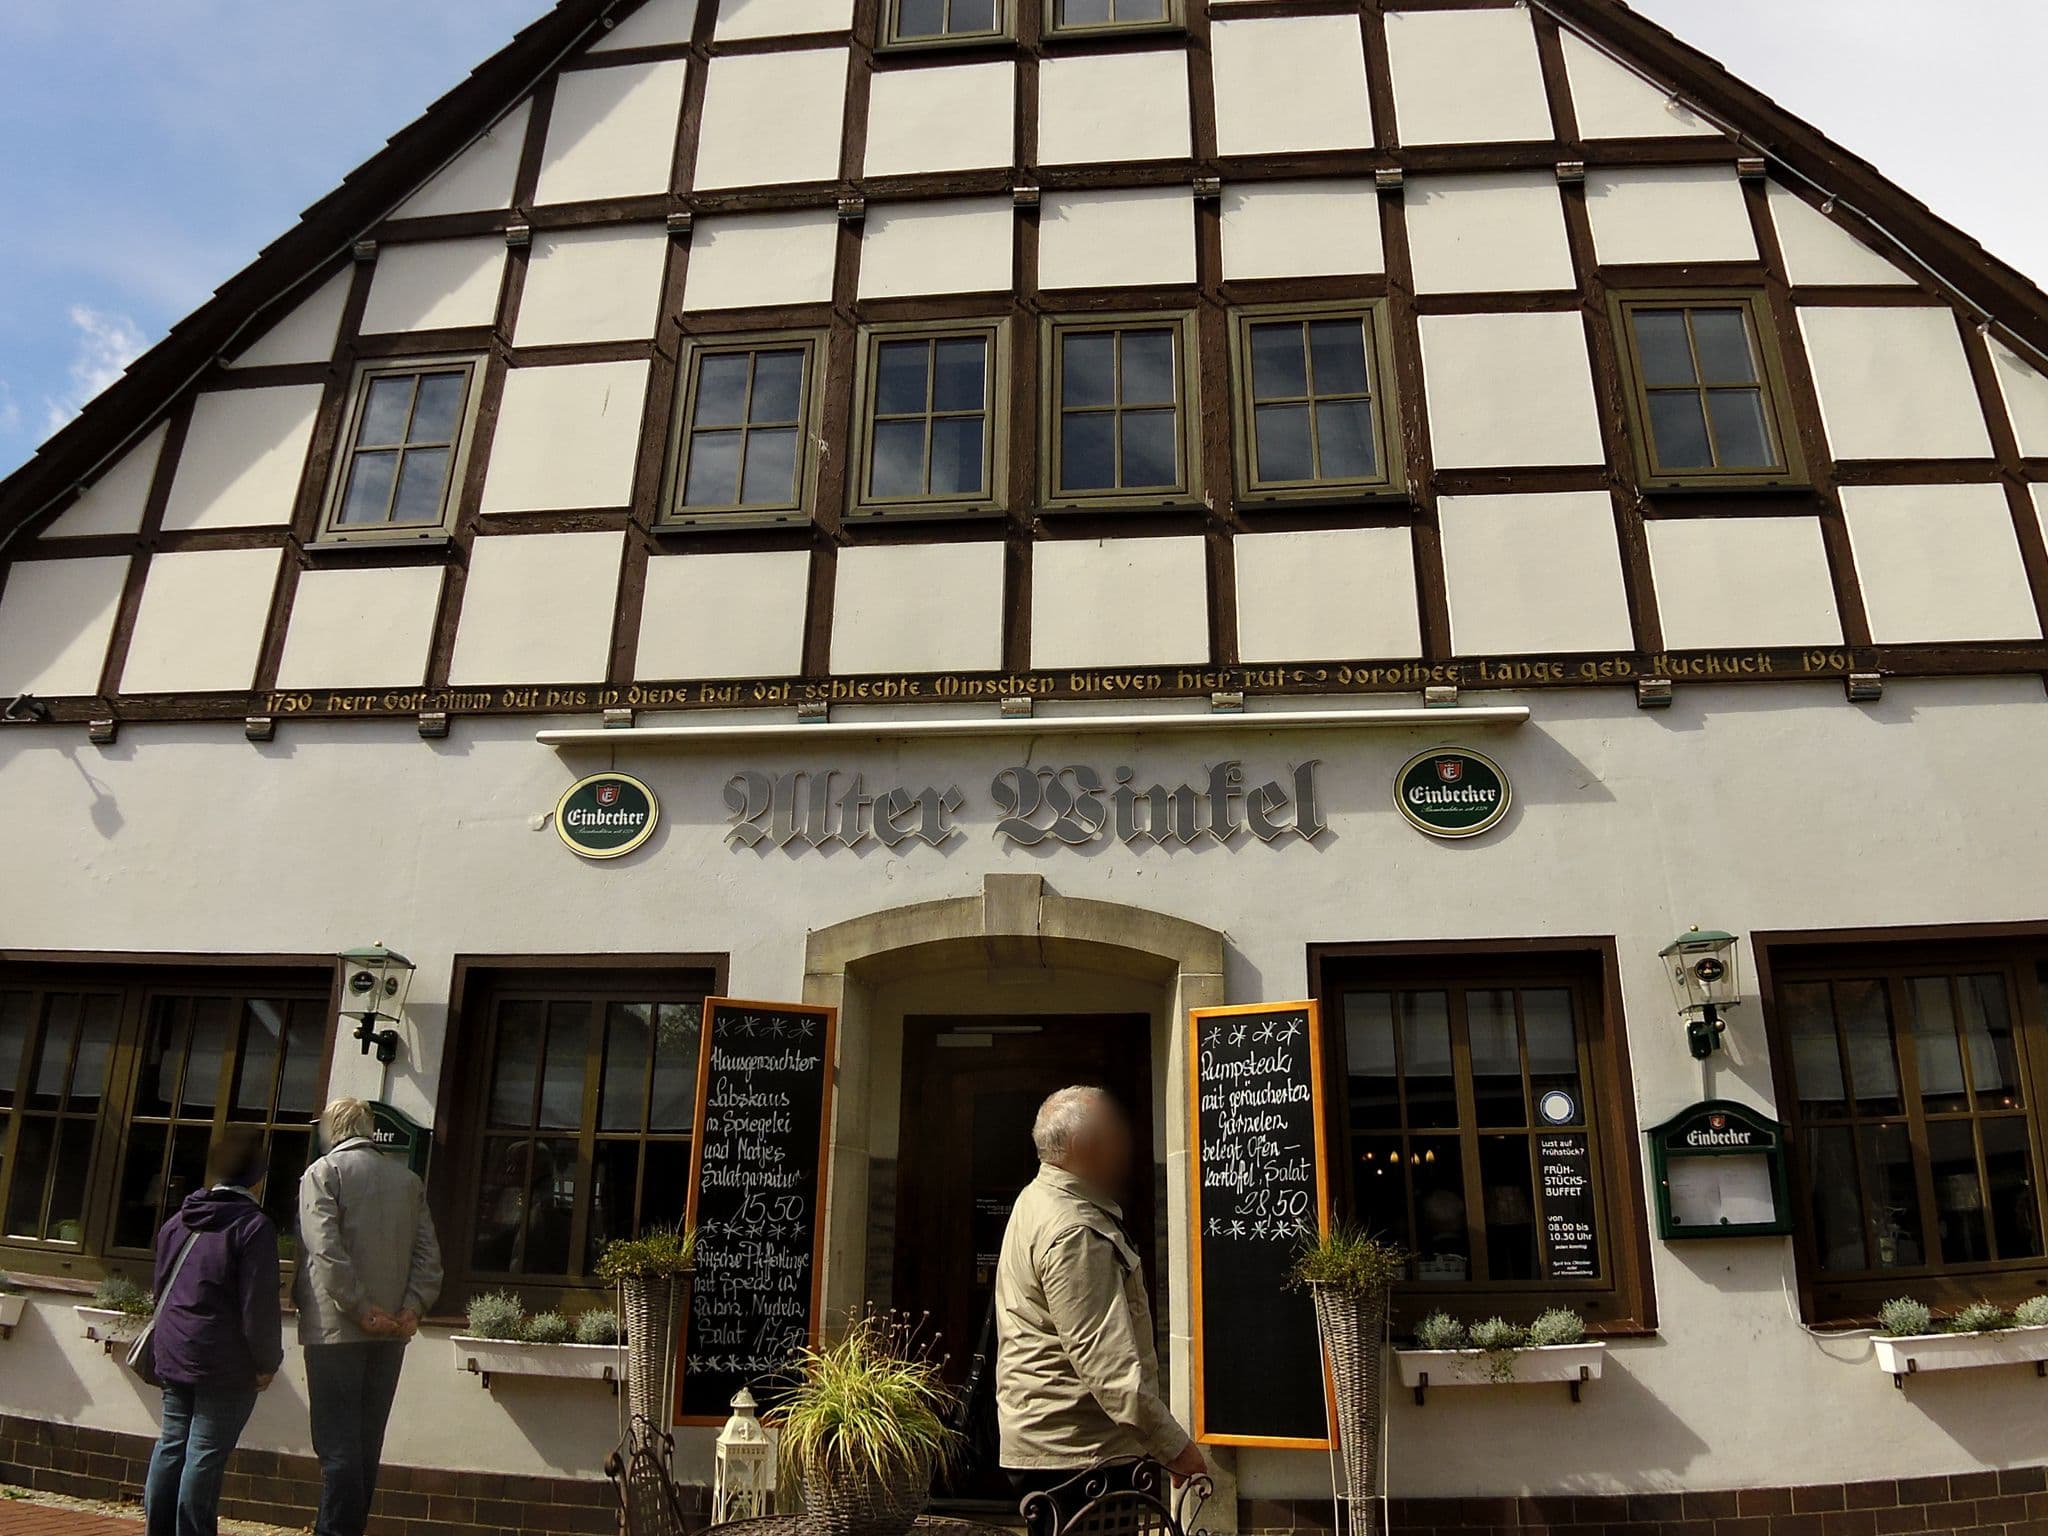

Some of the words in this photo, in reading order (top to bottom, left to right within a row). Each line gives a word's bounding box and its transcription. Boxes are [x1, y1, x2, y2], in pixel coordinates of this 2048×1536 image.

[384, 690, 428, 711] Gott
[598, 688, 619, 705] in
[628, 685, 688, 704] diene
[753, 681, 791, 701] dat
[805, 677, 921, 700] schlechte
[935, 675, 1055, 696] Minschen
[1070, 672, 1162, 692] blieven
[1177, 669, 1231, 689] hier
[1480, 660, 1565, 682] Lange
[1580, 657, 1639, 681] geb.
[723, 768, 967, 848] Alter
[991, 759, 1329, 847] Winkel
[1409, 784, 1496, 805] Einbecker
[567, 808, 645, 826] Einbecker
[1201, 1046, 1293, 1088] Rumpsteak
[708, 1076, 790, 1108] Labskaus
[1202, 1084, 1225, 1112] mit
[1229, 1078, 1311, 1118] geräucherten
[723, 1110, 792, 1141] Spiegelei
[1218, 1110, 1288, 1142] Garnelen
[1686, 1128, 1752, 1146] Einbecker
[704, 1139, 730, 1160] und
[1202, 1136, 1243, 1172] belegt
[701, 1163, 803, 1198] Salatgarnitur
[1263, 1157, 1312, 1188] Salat
[1543, 1163, 1575, 1174] FRÜH-
[1544, 1174, 1588, 1186] STÜCKS-
[1545, 1186, 1582, 1197] BUFFET
[1235, 1189, 1308, 1228] 28,50
[1550, 1232, 1575, 1241] 10.30
[1576, 1232, 1593, 1241] Uhr
[1576, 1222, 1590, 1231] bis
[696, 1239, 742, 1271] Frische
[694, 1271, 716, 1293] mit
[719, 1272, 774, 1300] Speck
[778, 1272, 797, 1292] in
[752, 1293, 805, 1317] Nudeln
[698, 1318, 747, 1350] Salat
